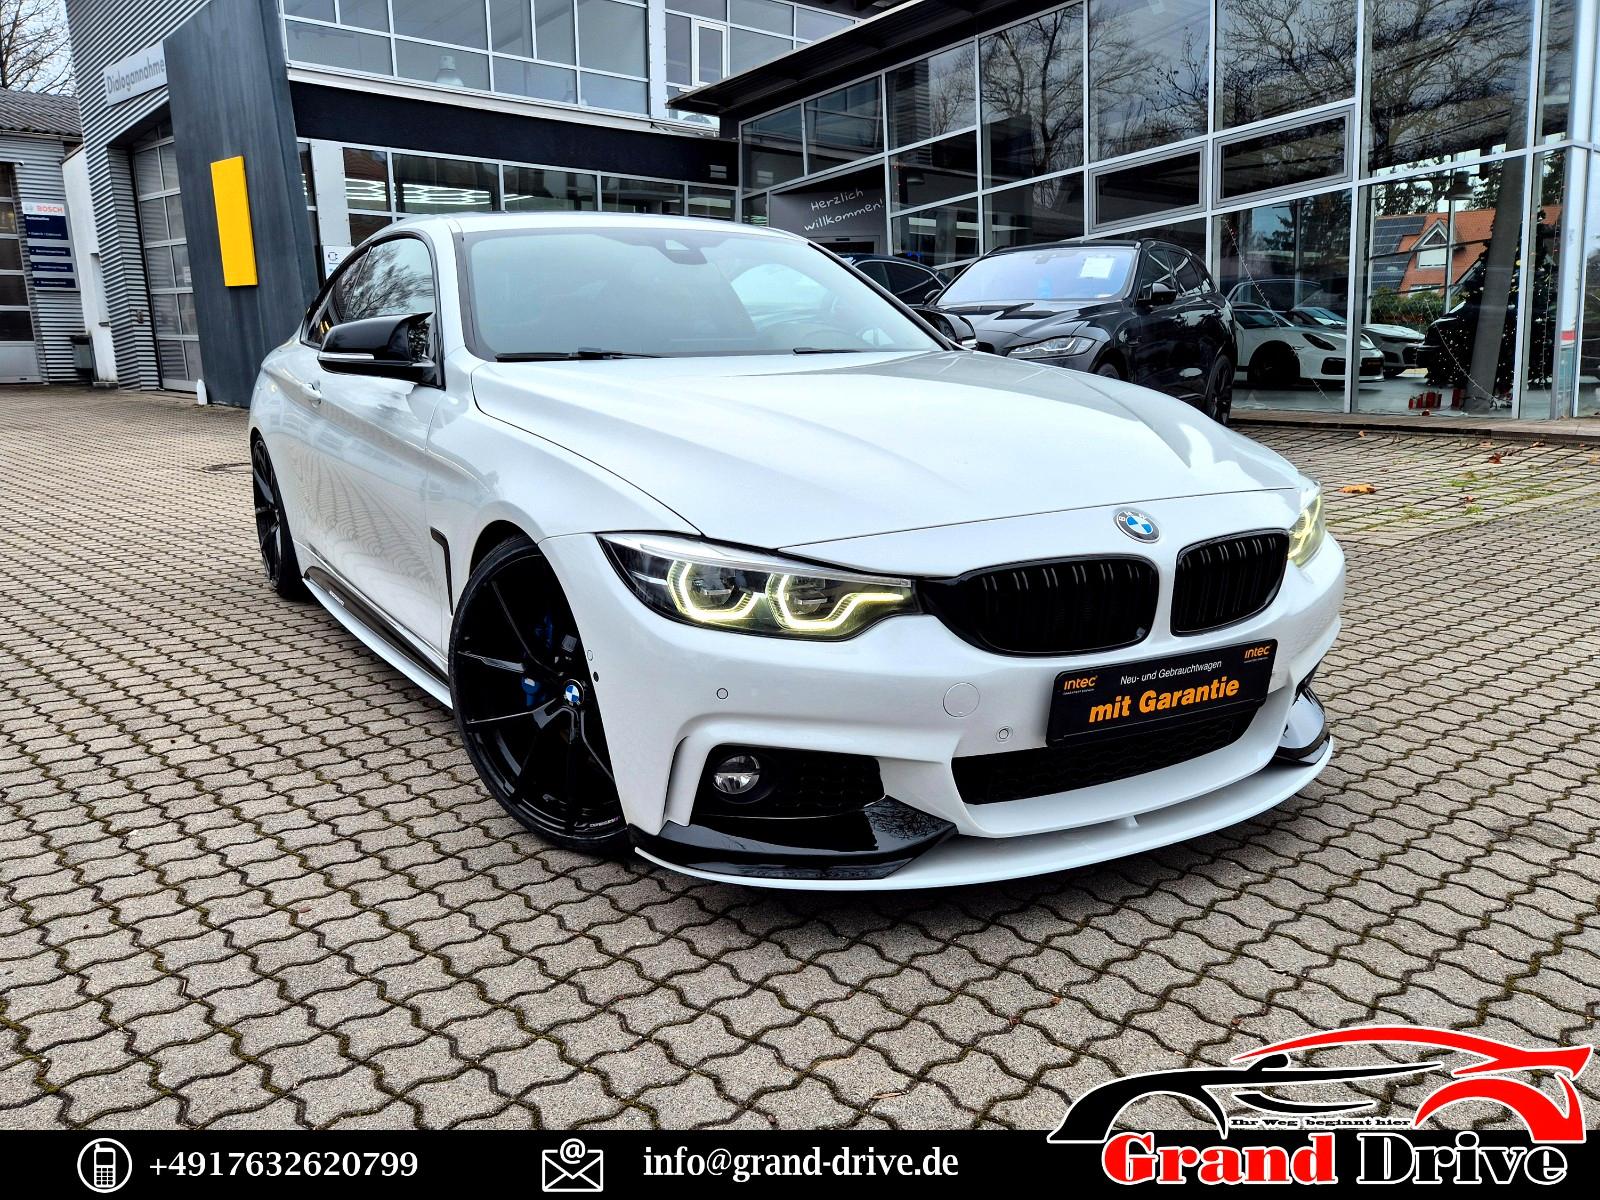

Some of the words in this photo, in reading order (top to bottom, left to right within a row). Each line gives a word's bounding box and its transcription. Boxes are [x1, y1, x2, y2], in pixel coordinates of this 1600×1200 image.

[106, 56, 165, 92] Dialogannahme
[36, 205, 65, 213] BOSCH
[810, 188, 864, 211] Herzlich
[804, 198, 884, 231] willkommen!
[1244, 645, 1271, 659] intec
[1063, 675, 1097, 690] intec
[1120, 675, 1139, 685] Neu-
[1141, 669, 1158, 682] und
[1158, 660, 1222, 678] Gebrauchtwagen
[1088, 695, 1131, 723] mit
[1139, 676, 1240, 713] Garantie
